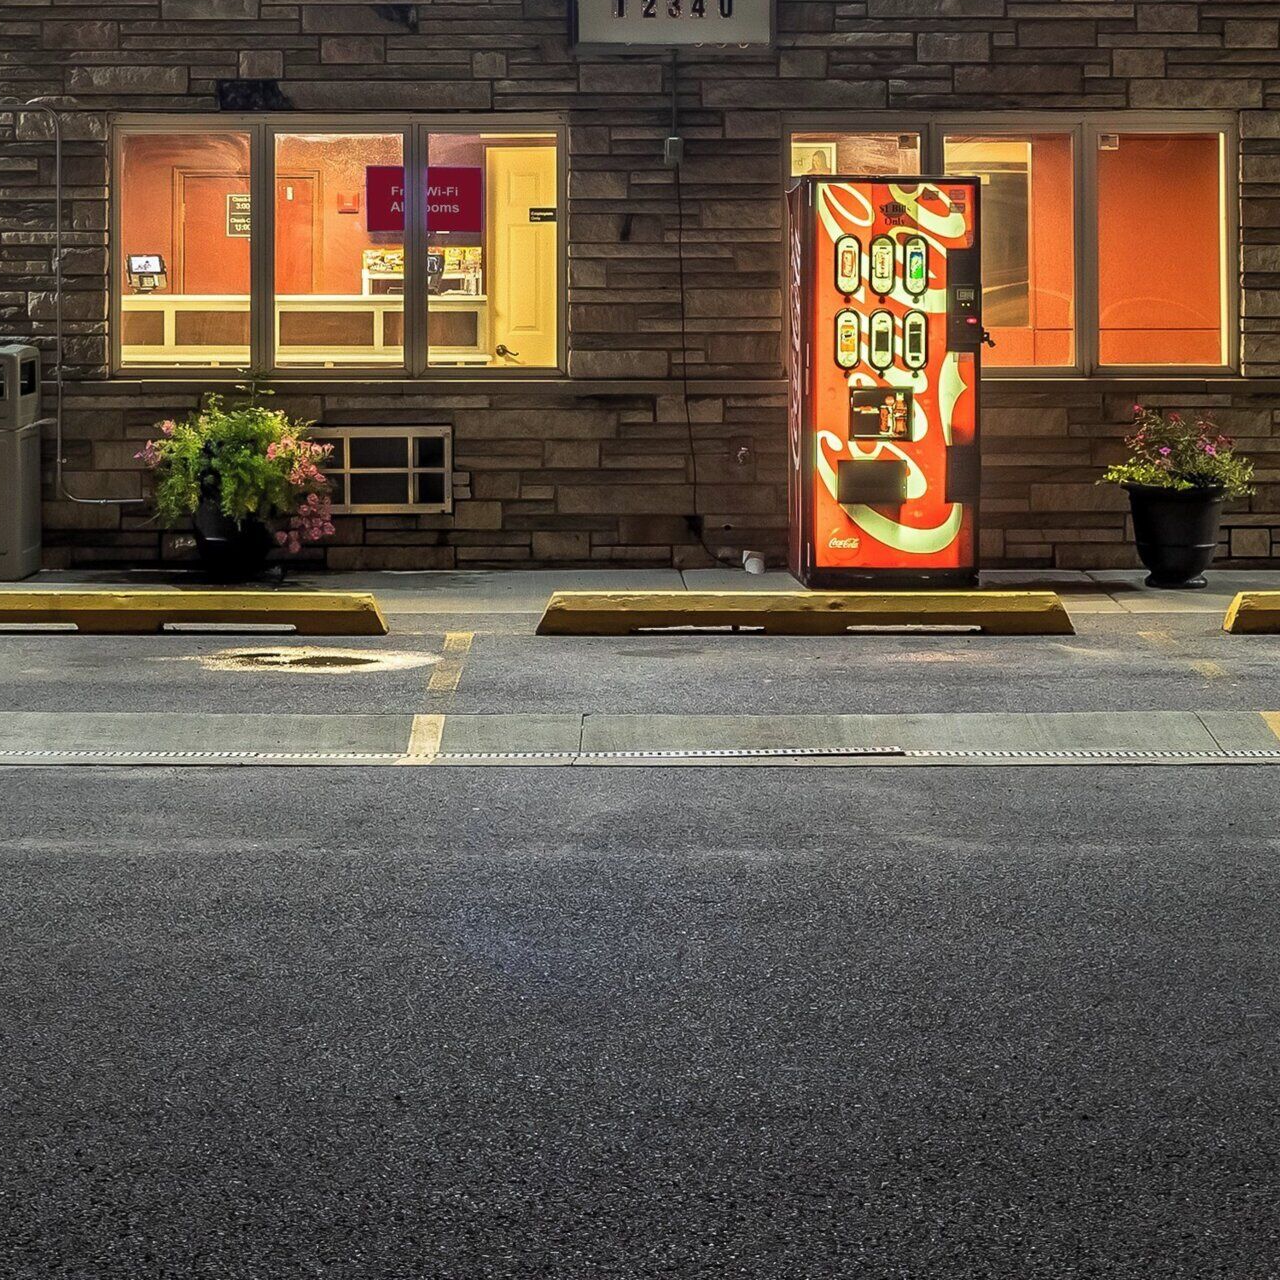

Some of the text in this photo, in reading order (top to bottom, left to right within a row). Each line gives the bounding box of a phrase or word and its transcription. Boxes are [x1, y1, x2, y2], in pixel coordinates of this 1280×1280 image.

[391, 186, 459, 196] Fr Wi-Fi
[390, 201, 404, 213] Al
